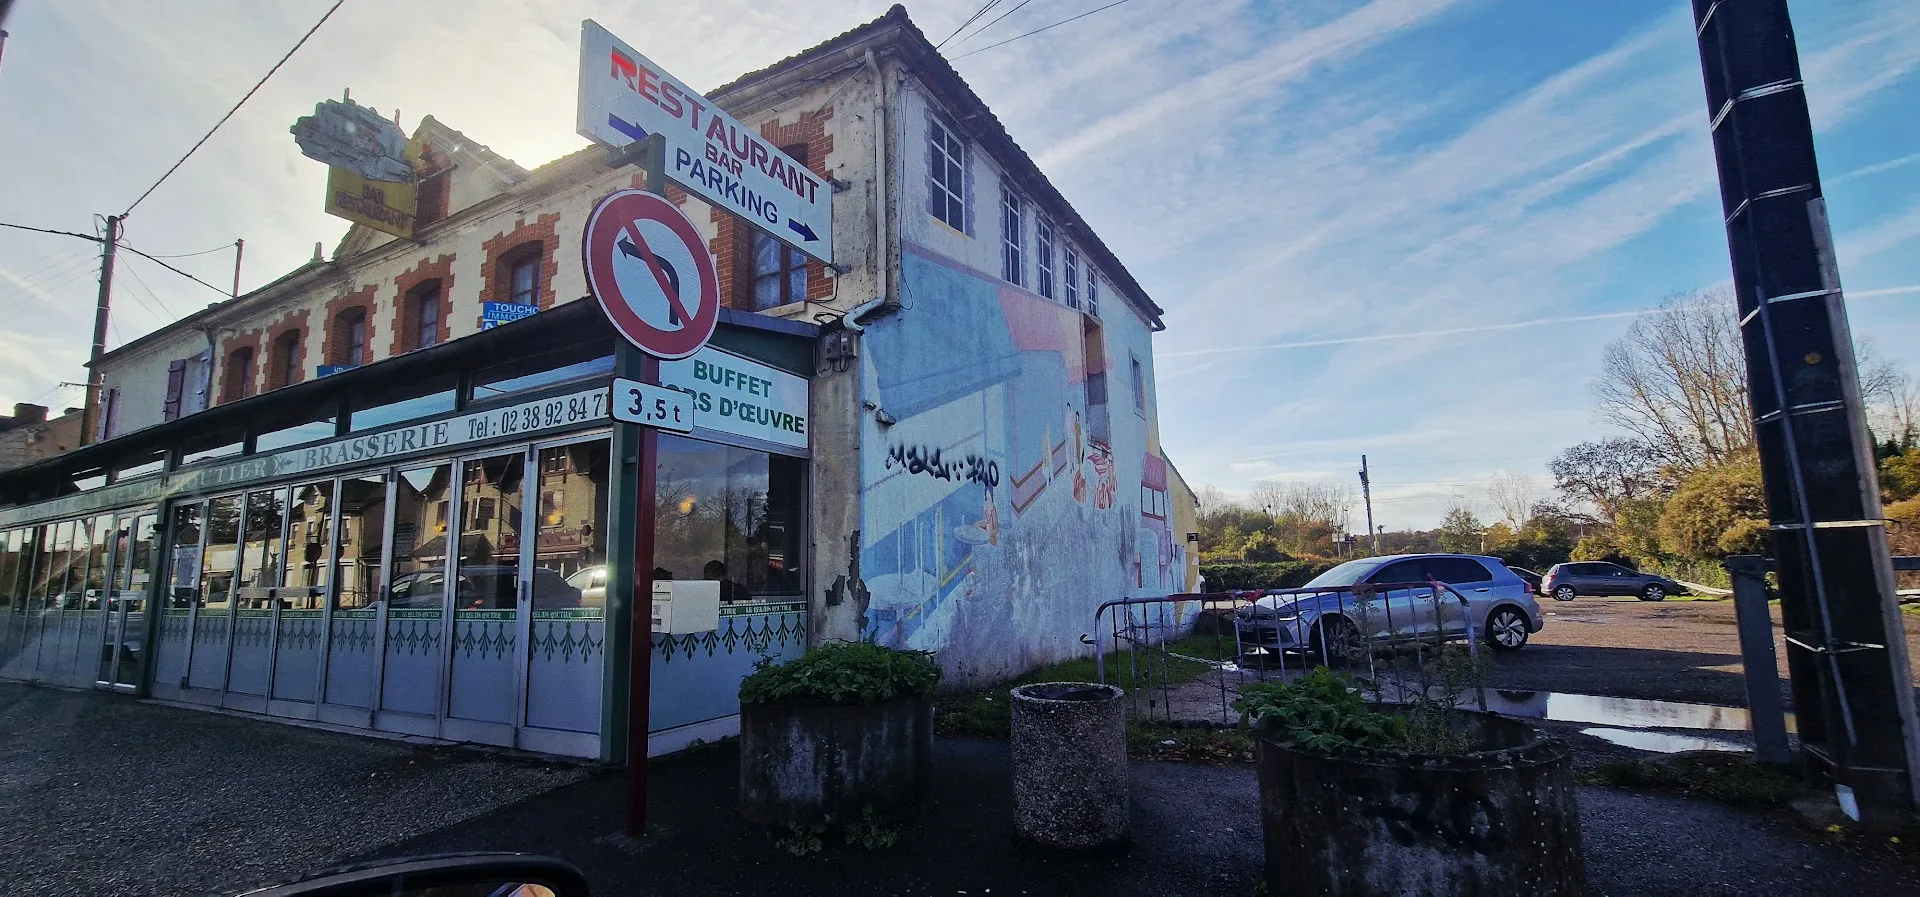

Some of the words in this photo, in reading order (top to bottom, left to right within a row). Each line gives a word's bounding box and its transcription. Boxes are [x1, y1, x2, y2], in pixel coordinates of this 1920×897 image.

[610, 44, 820, 205] RESTAURANT
[704, 141, 743, 180] BAR
[675, 147, 778, 224] PARKING
[693, 358, 773, 399] BUFFET
[628, 388, 667, 421] 3,5
[673, 405, 681, 423] t
[719, 396, 806, 435] D'ŒUVRE
[303, 421, 449, 470] BRASSERIE
[501, 409, 518, 434] 02
[522, 405, 540, 431] 38
[545, 401, 563, 427] 92
[568, 396, 588, 422] 84
